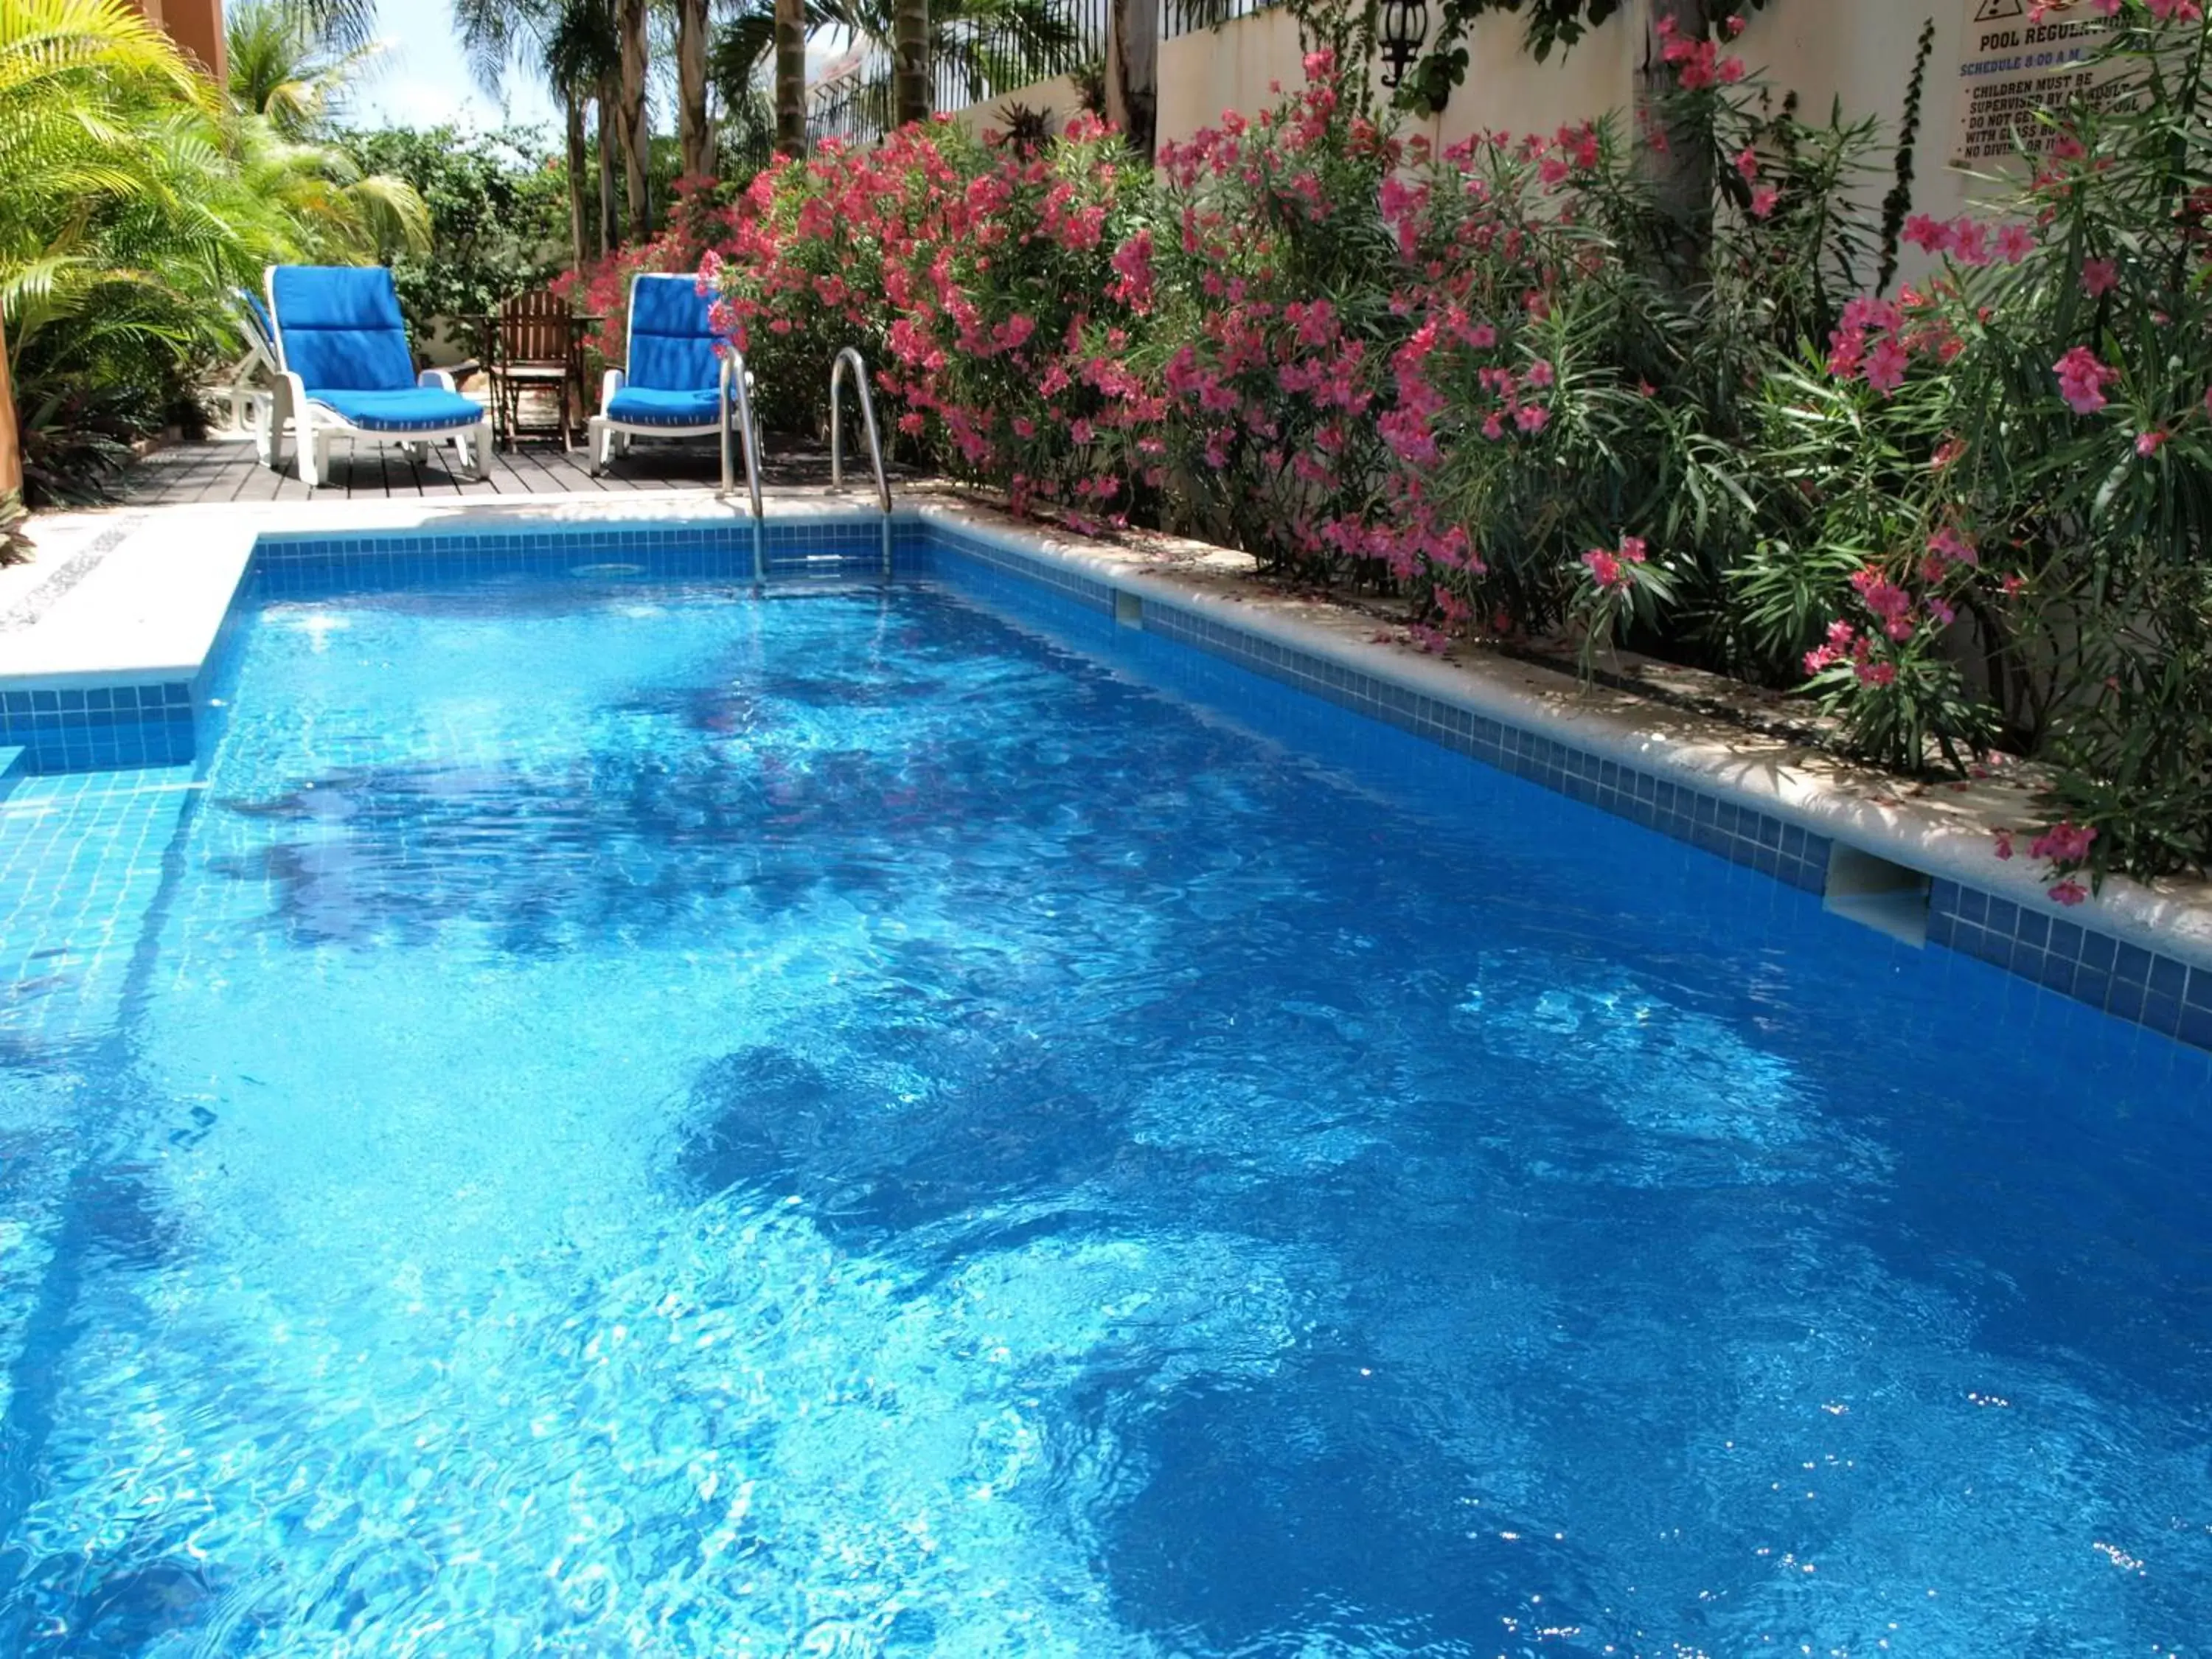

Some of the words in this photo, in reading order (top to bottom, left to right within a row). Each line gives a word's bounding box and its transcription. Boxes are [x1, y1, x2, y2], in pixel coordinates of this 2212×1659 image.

[1980, 31, 2020, 52] POOL
[1960, 57, 2021, 76] SCHEDULE
[1973, 80, 2032, 99] CHILDREN
[2037, 74, 2072, 91] MUST
[2076, 73, 2093, 86] BE
[2047, 91, 2064, 105] BY
[1969, 116, 1984, 129] DO
[1988, 113, 2011, 126] NOT
[1966, 130, 1996, 143] WITH
[1965, 145, 1980, 159] NO
[2027, 139, 2041, 152] OR
